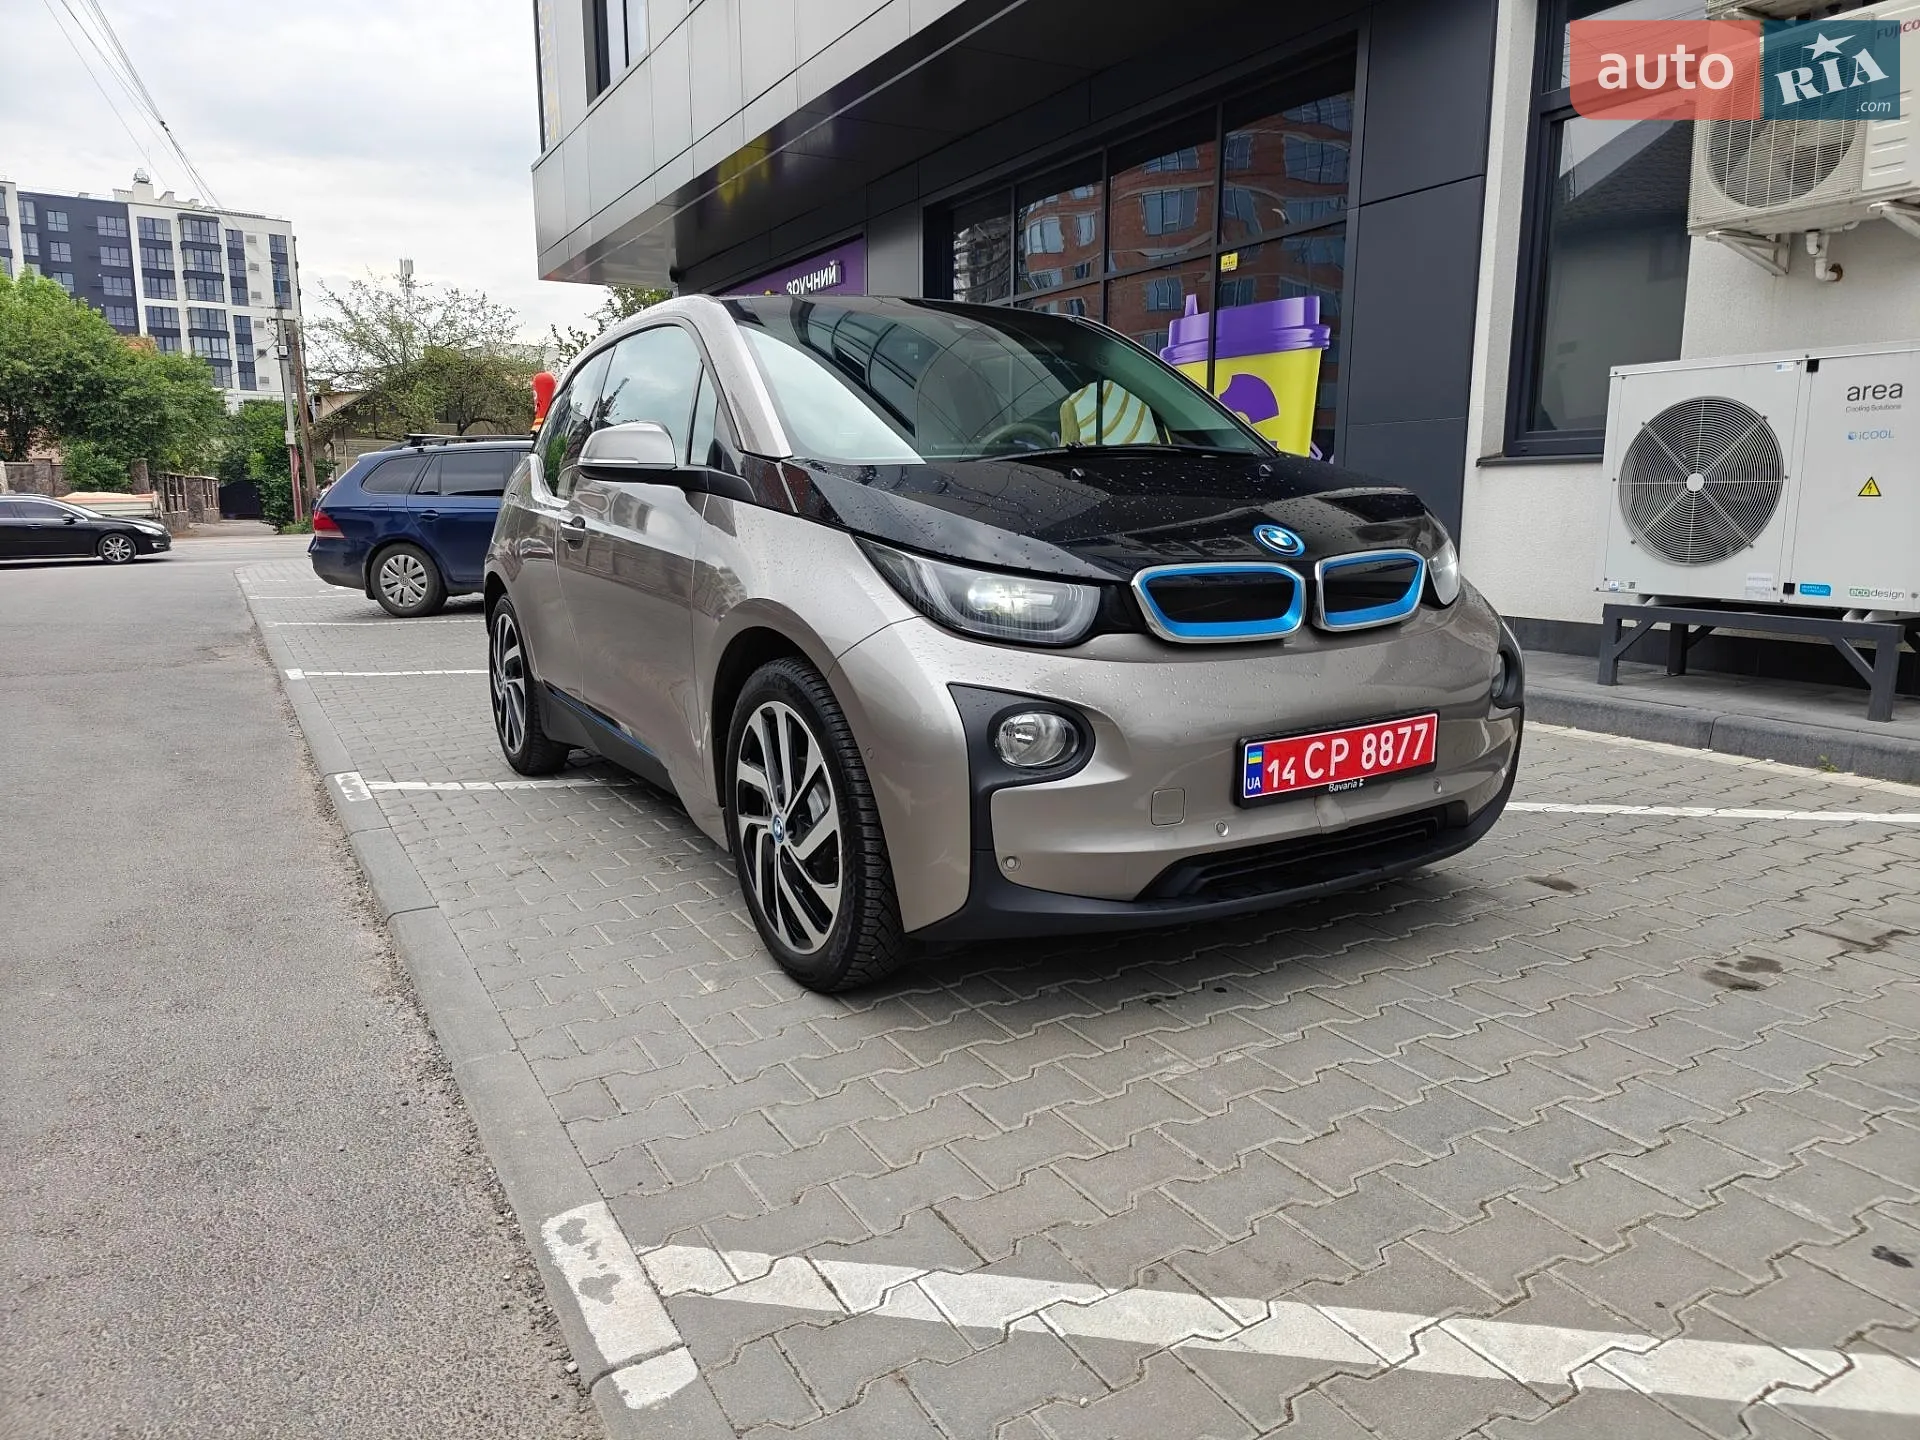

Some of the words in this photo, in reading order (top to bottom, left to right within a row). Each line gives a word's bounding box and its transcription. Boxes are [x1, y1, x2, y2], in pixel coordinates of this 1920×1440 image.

[1846, 383, 1903, 402] area
[1267, 756, 1296, 788] 14
[1304, 738, 1349, 779] CP
[1361, 722, 1429, 770] 8877
[1246, 778, 1261, 790] UA
[1328, 779, 1358, 792] Bavaria
